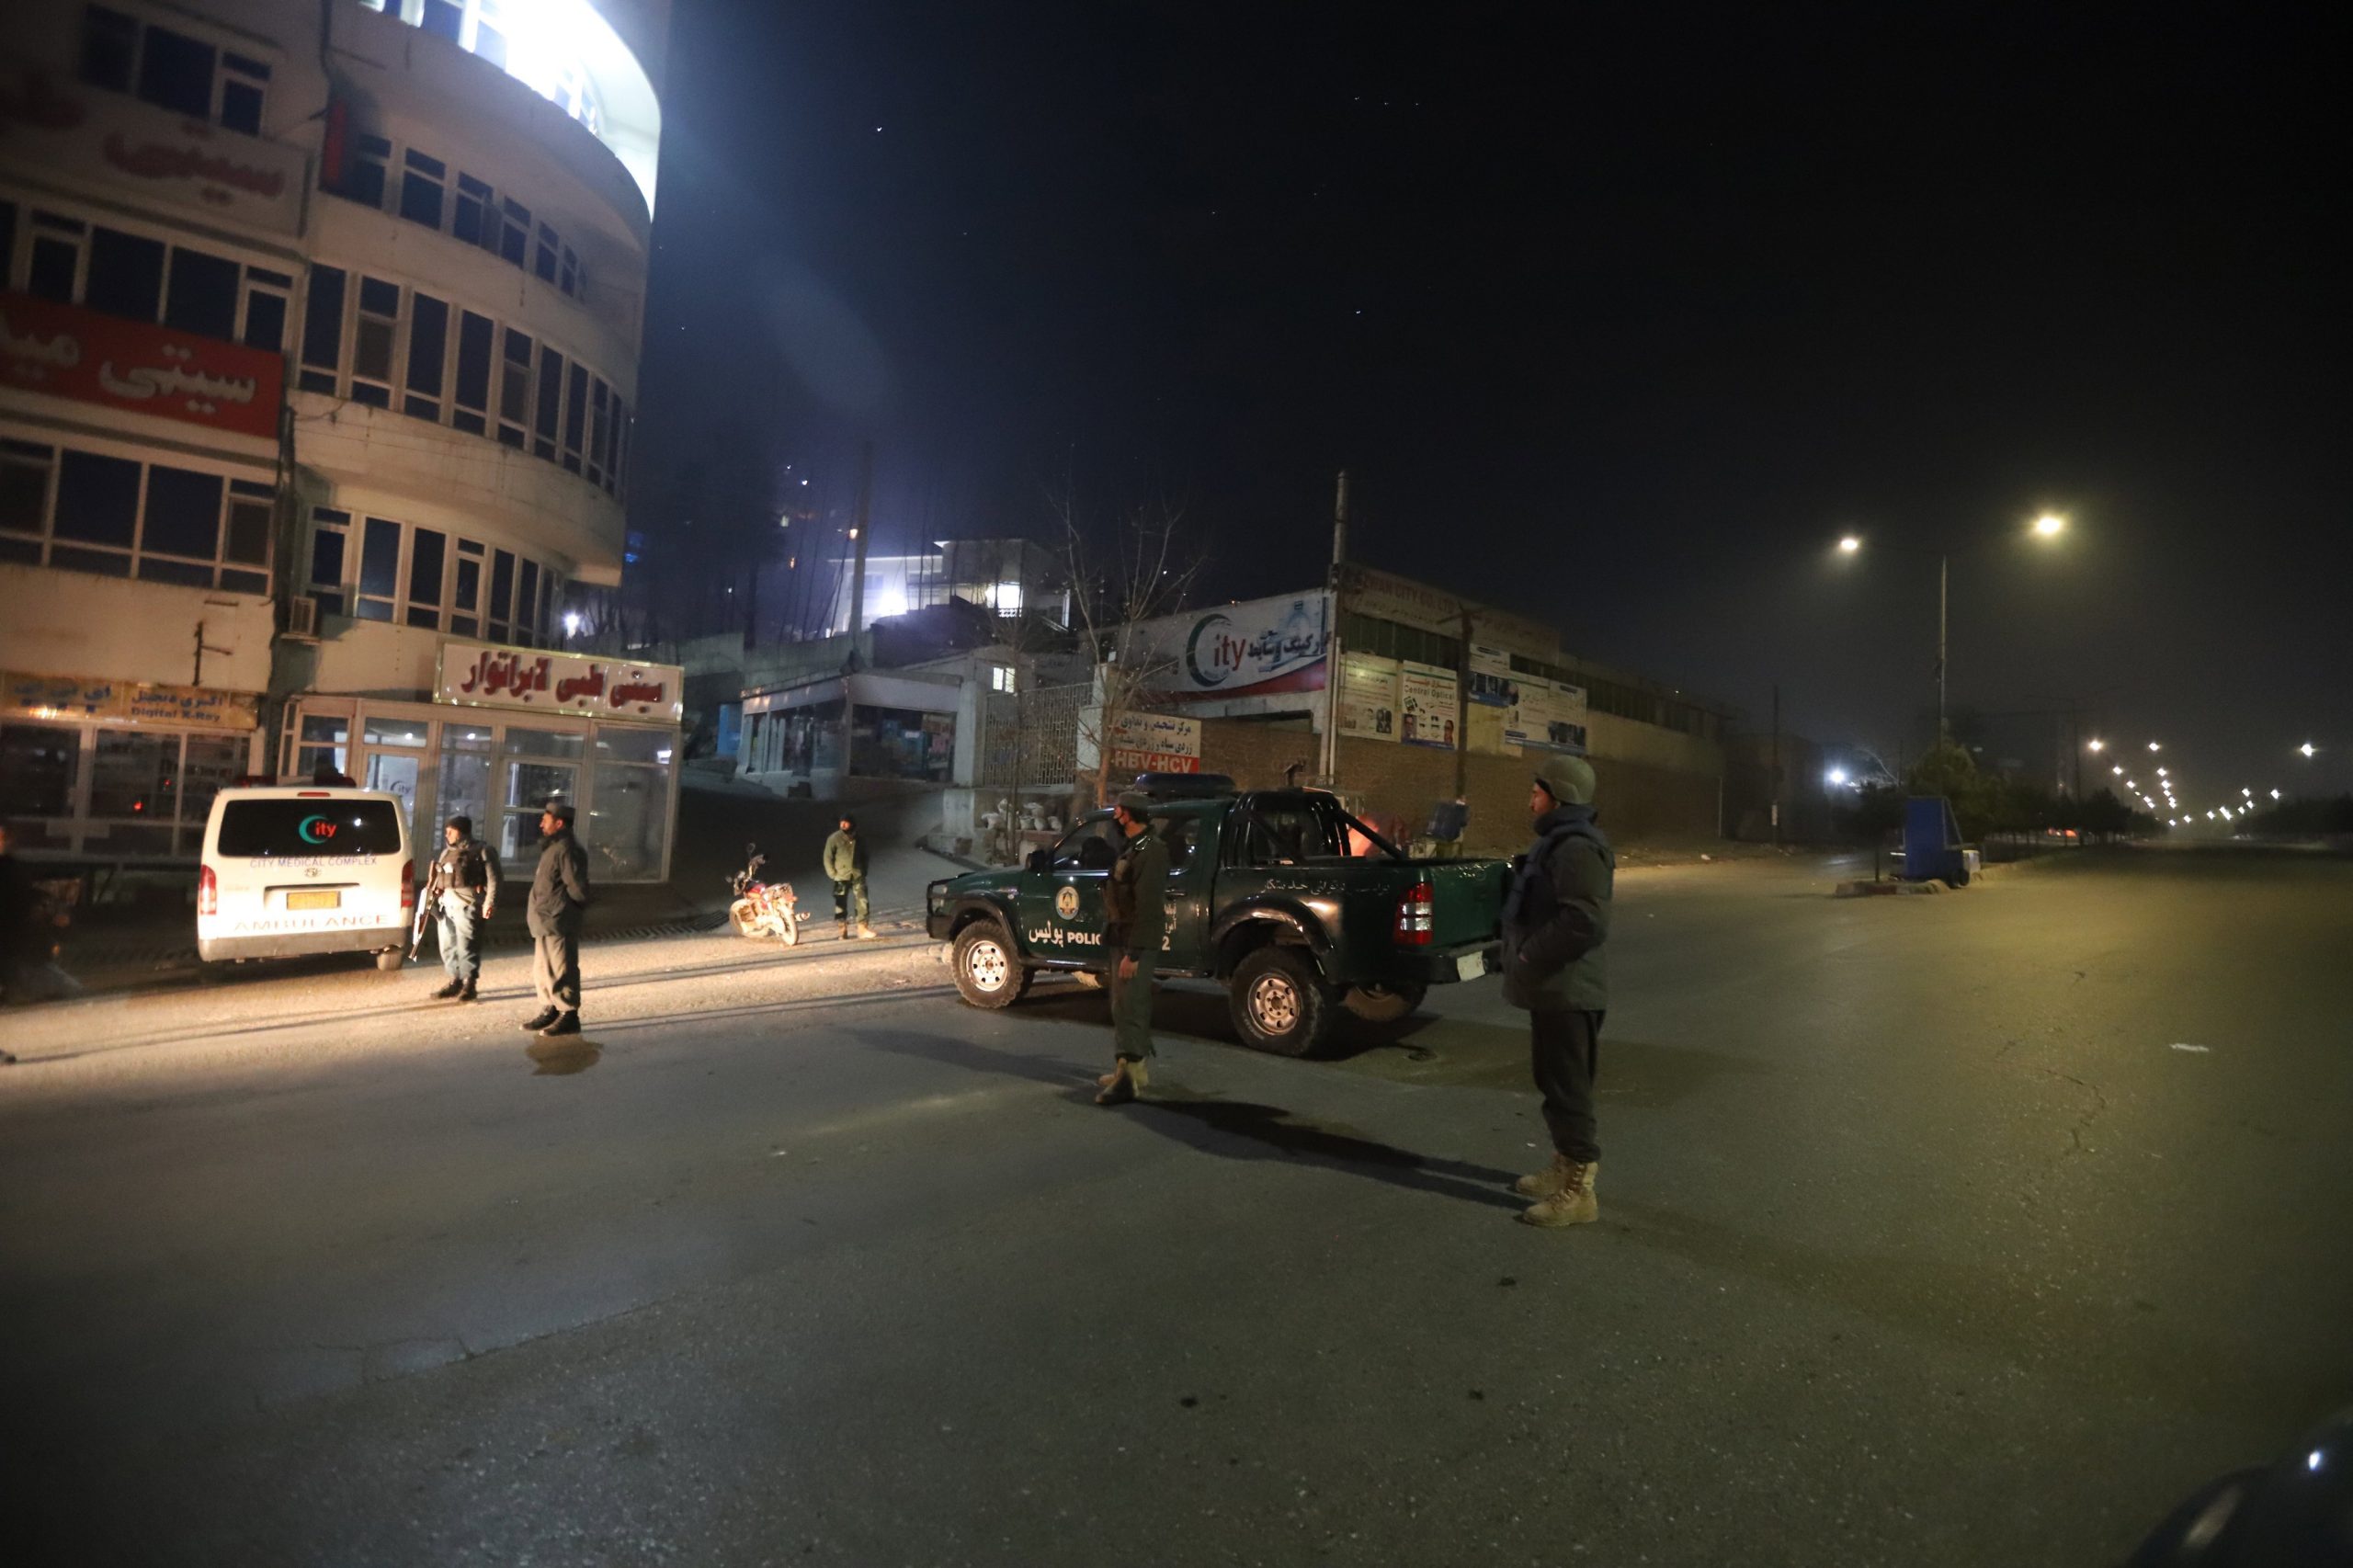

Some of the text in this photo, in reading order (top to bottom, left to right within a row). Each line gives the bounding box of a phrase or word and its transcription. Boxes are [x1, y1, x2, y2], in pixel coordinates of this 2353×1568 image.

[250, 856, 378, 869] CITY MEDICAL COMPLEX
[1029, 920, 1064, 948] پولیس
[1067, 931, 1101, 946] POLIC
